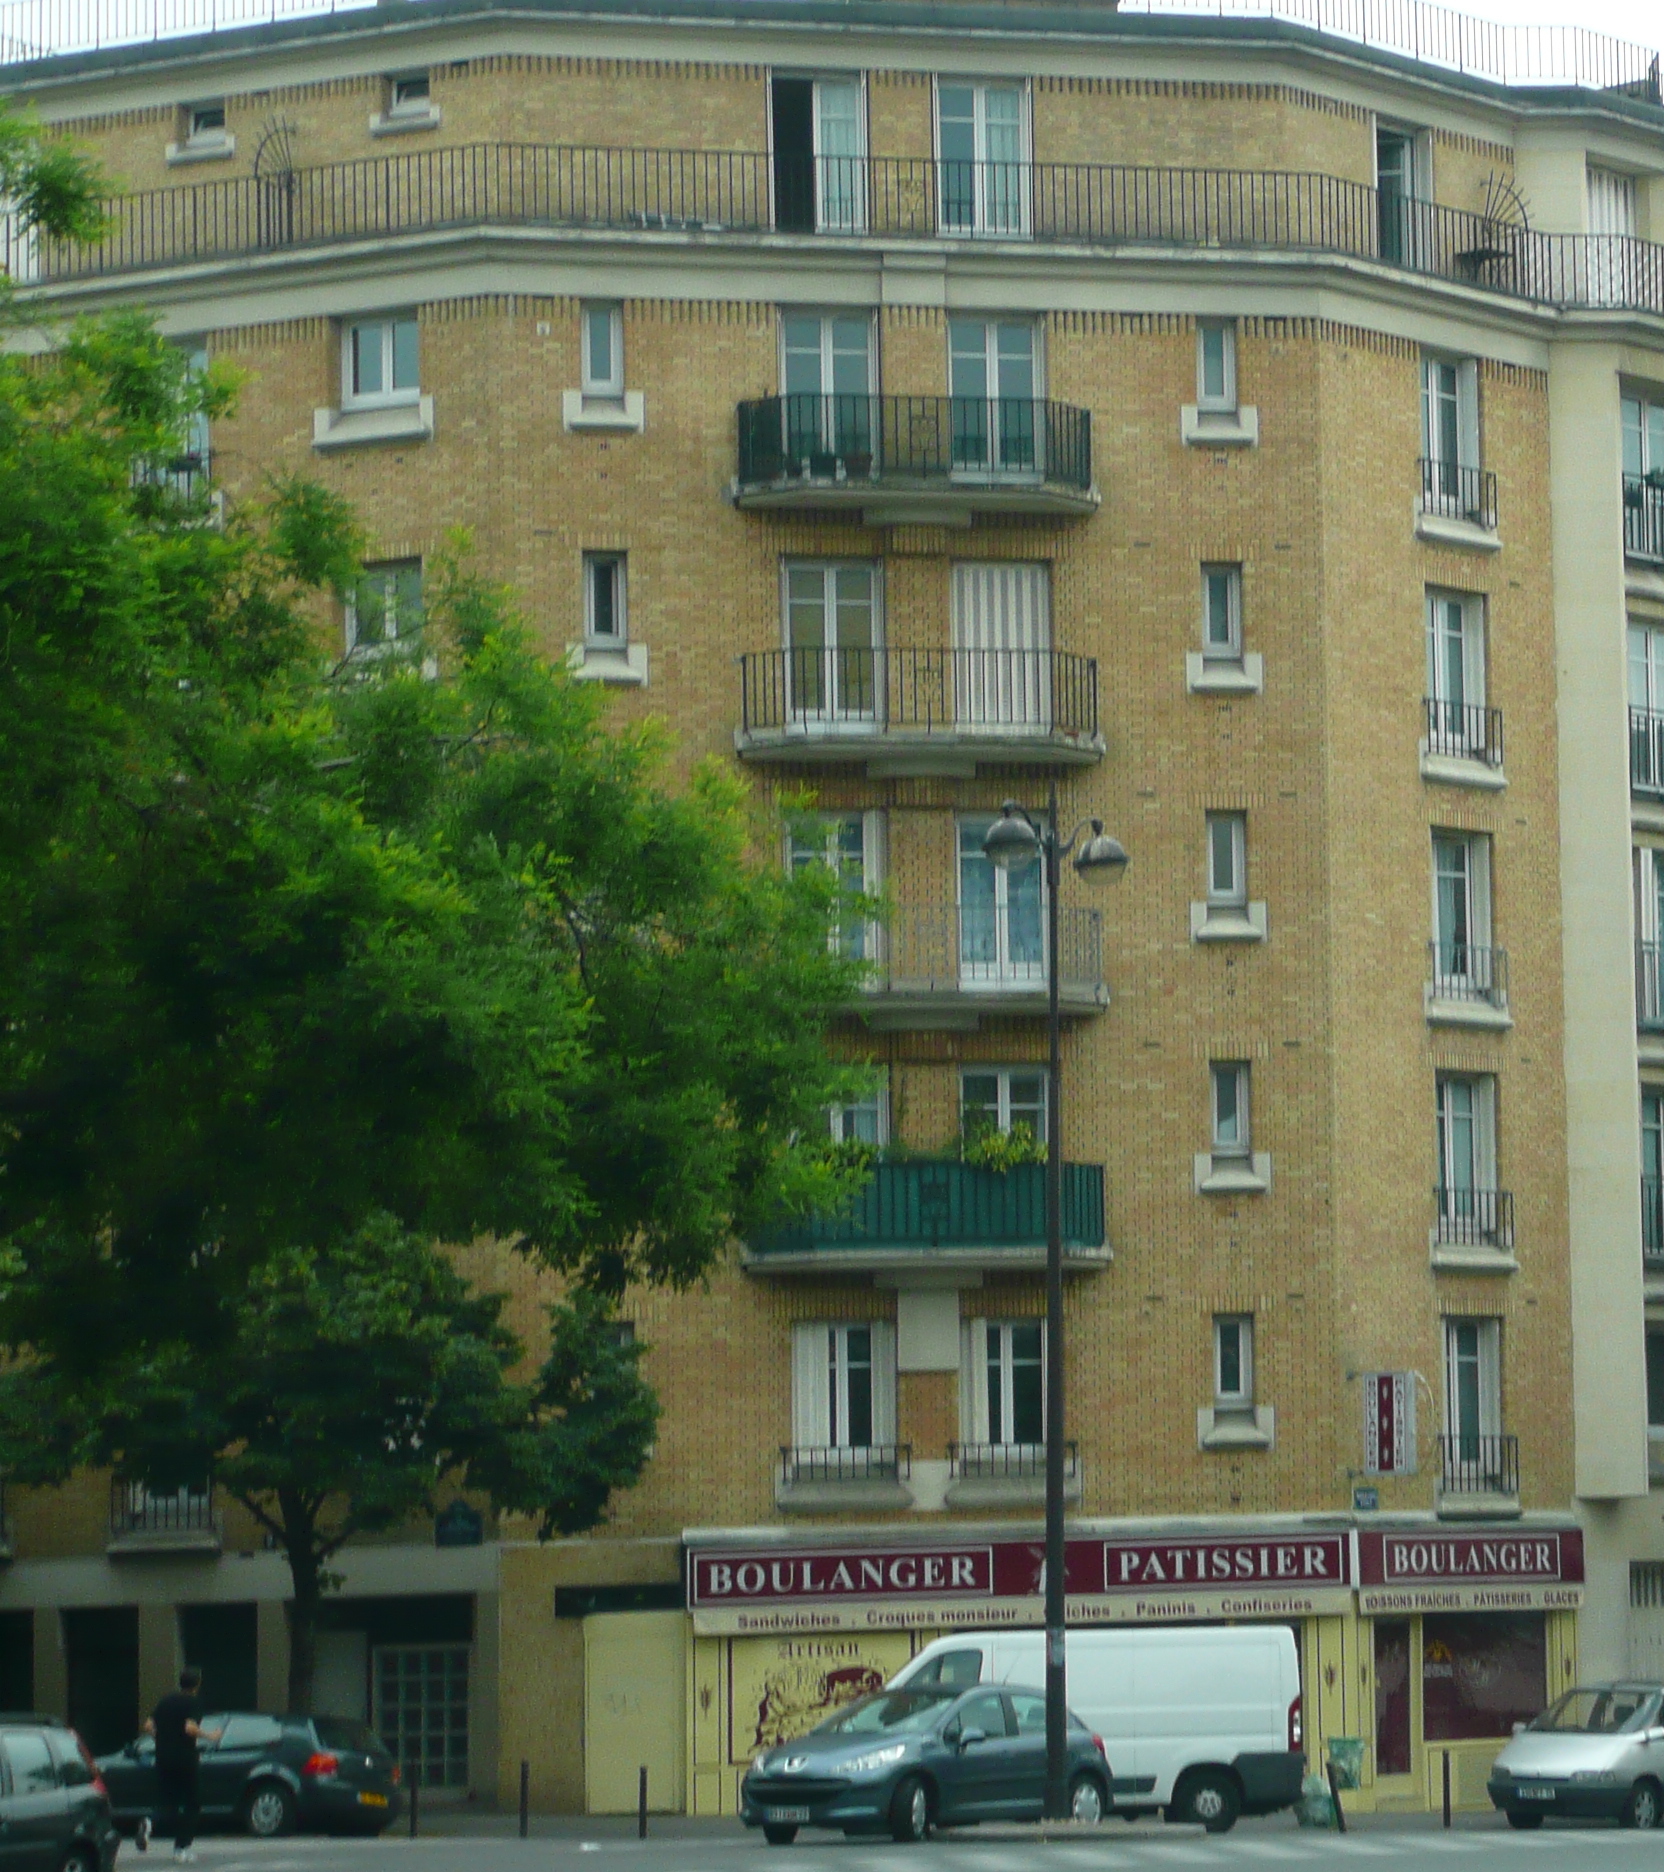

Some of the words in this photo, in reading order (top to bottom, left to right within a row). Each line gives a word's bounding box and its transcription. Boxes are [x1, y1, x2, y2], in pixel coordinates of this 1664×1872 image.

[1119, 1545, 1328, 1582] PATISSIER
[1394, 1541, 1552, 1574] BOULANGER
[709, 1554, 977, 1596] BOULANGER
[738, 1614, 841, 1630] Sandwiches
[867, 1608, 935, 1625] Croques
[941, 1605, 1018, 1622] monsieur
[1136, 1600, 1196, 1616] Paninis
[1221, 1597, 1312, 1613] Confiseries
[1544, 1590, 1580, 1605] GLACES
